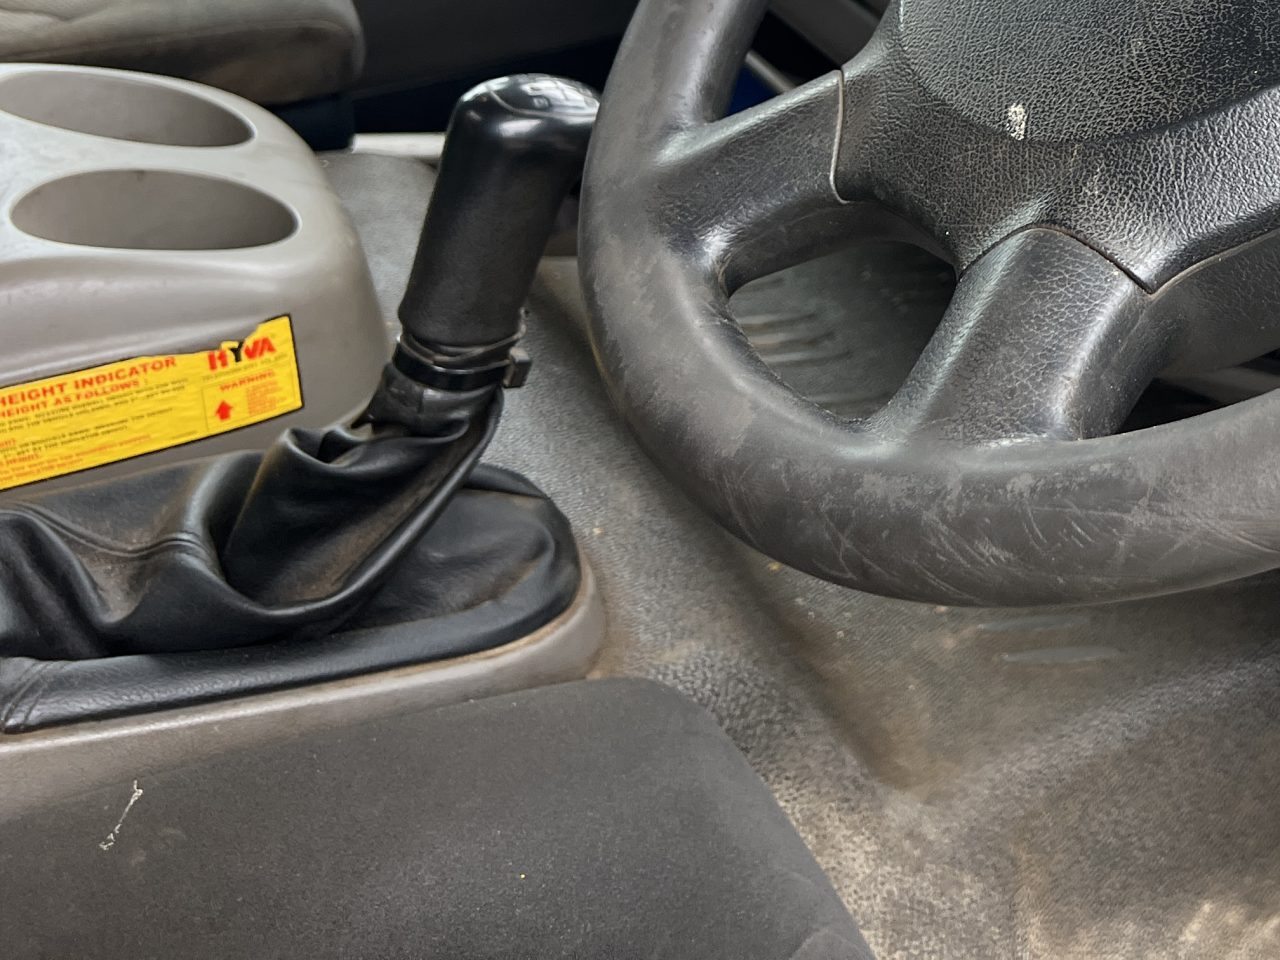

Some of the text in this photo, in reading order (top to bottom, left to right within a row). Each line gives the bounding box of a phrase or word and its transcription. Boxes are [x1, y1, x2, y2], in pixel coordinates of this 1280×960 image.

[207, 337, 277, 371] HYVA
[74, 356, 177, 389] INDICATOR
[54, 396, 72, 406] AS
[75, 380, 140, 401] FOLLOWS
